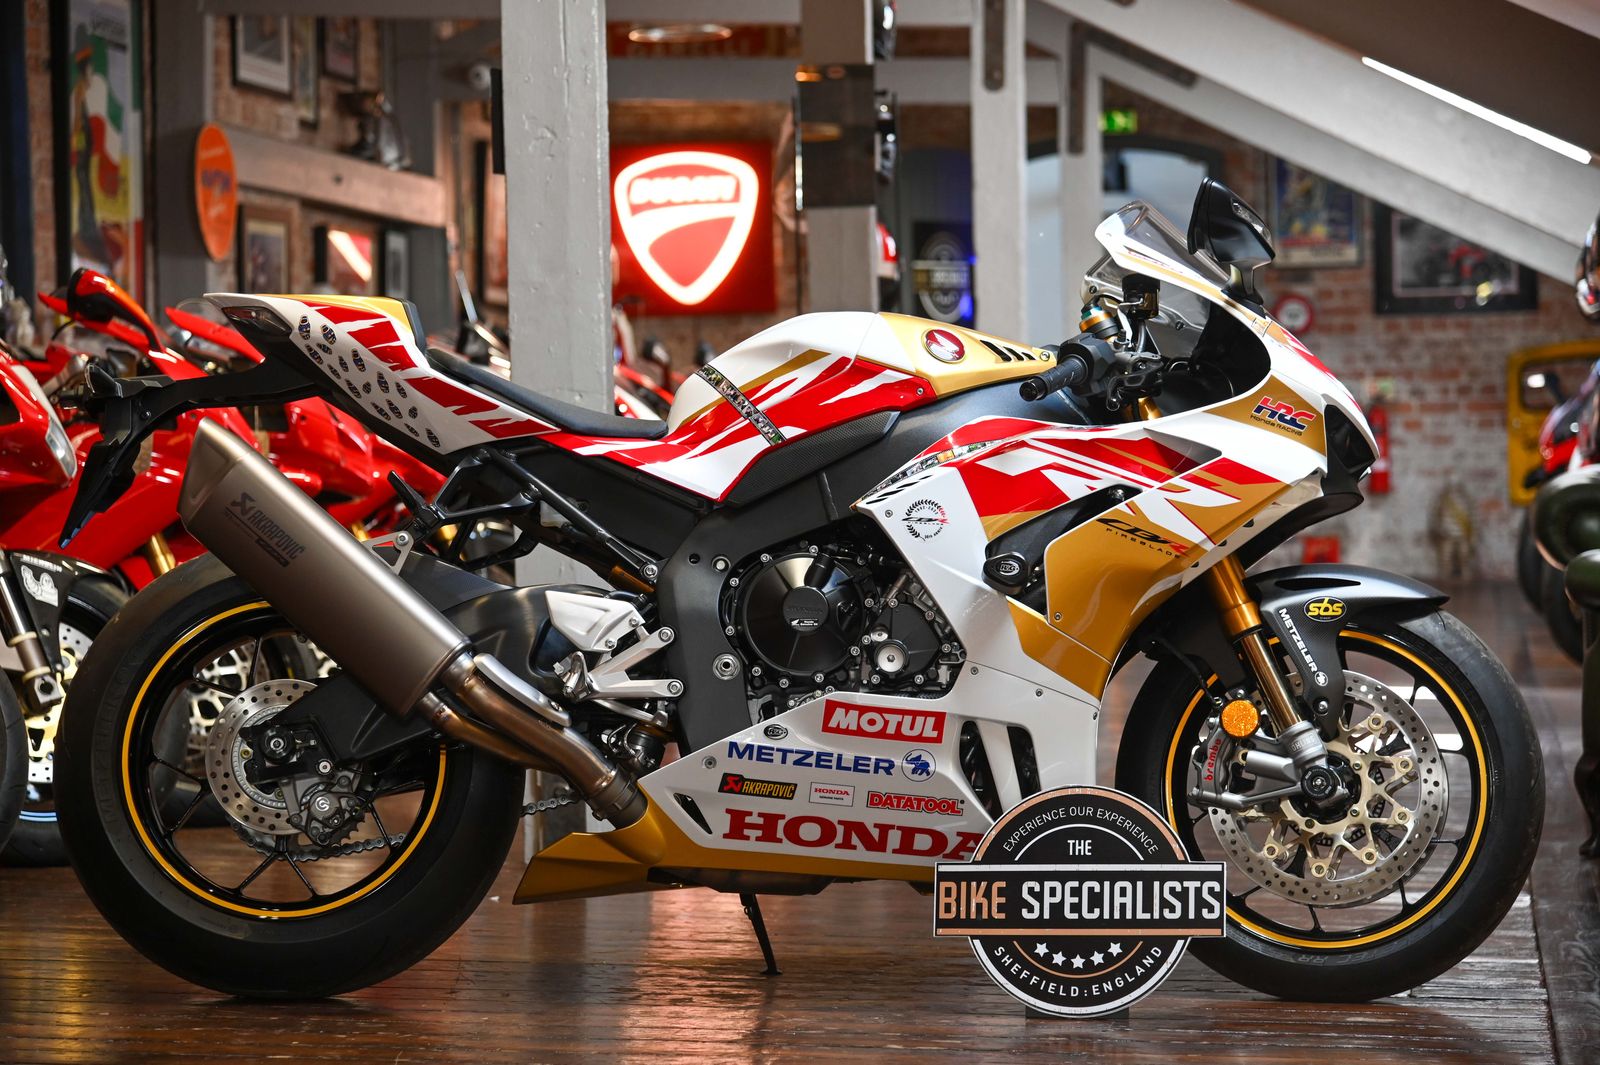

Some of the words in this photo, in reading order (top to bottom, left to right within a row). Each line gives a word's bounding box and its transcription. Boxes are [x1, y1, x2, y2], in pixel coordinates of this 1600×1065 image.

[1252, 396, 1316, 432] HRC
[1106, 527, 1180, 559] FIREBLADE
[1308, 597, 1344, 616] sbs
[1279, 608, 1318, 672] METZELER
[828, 708, 939, 738] MOTUL
[727, 741, 896, 775] METZELER
[1204, 739, 1222, 781] brembo
[814, 787, 850, 796] HONDA
[1002, 807, 1067, 852] EXPERIENCE
[1069, 806, 1094, 817] OUR
[1096, 808, 1159, 856] EXPERIENCE
[1067, 839, 1092, 856] THE
[938, 881, 1007, 920] BIKE
[1021, 880, 1221, 920] SPECIALISTS
